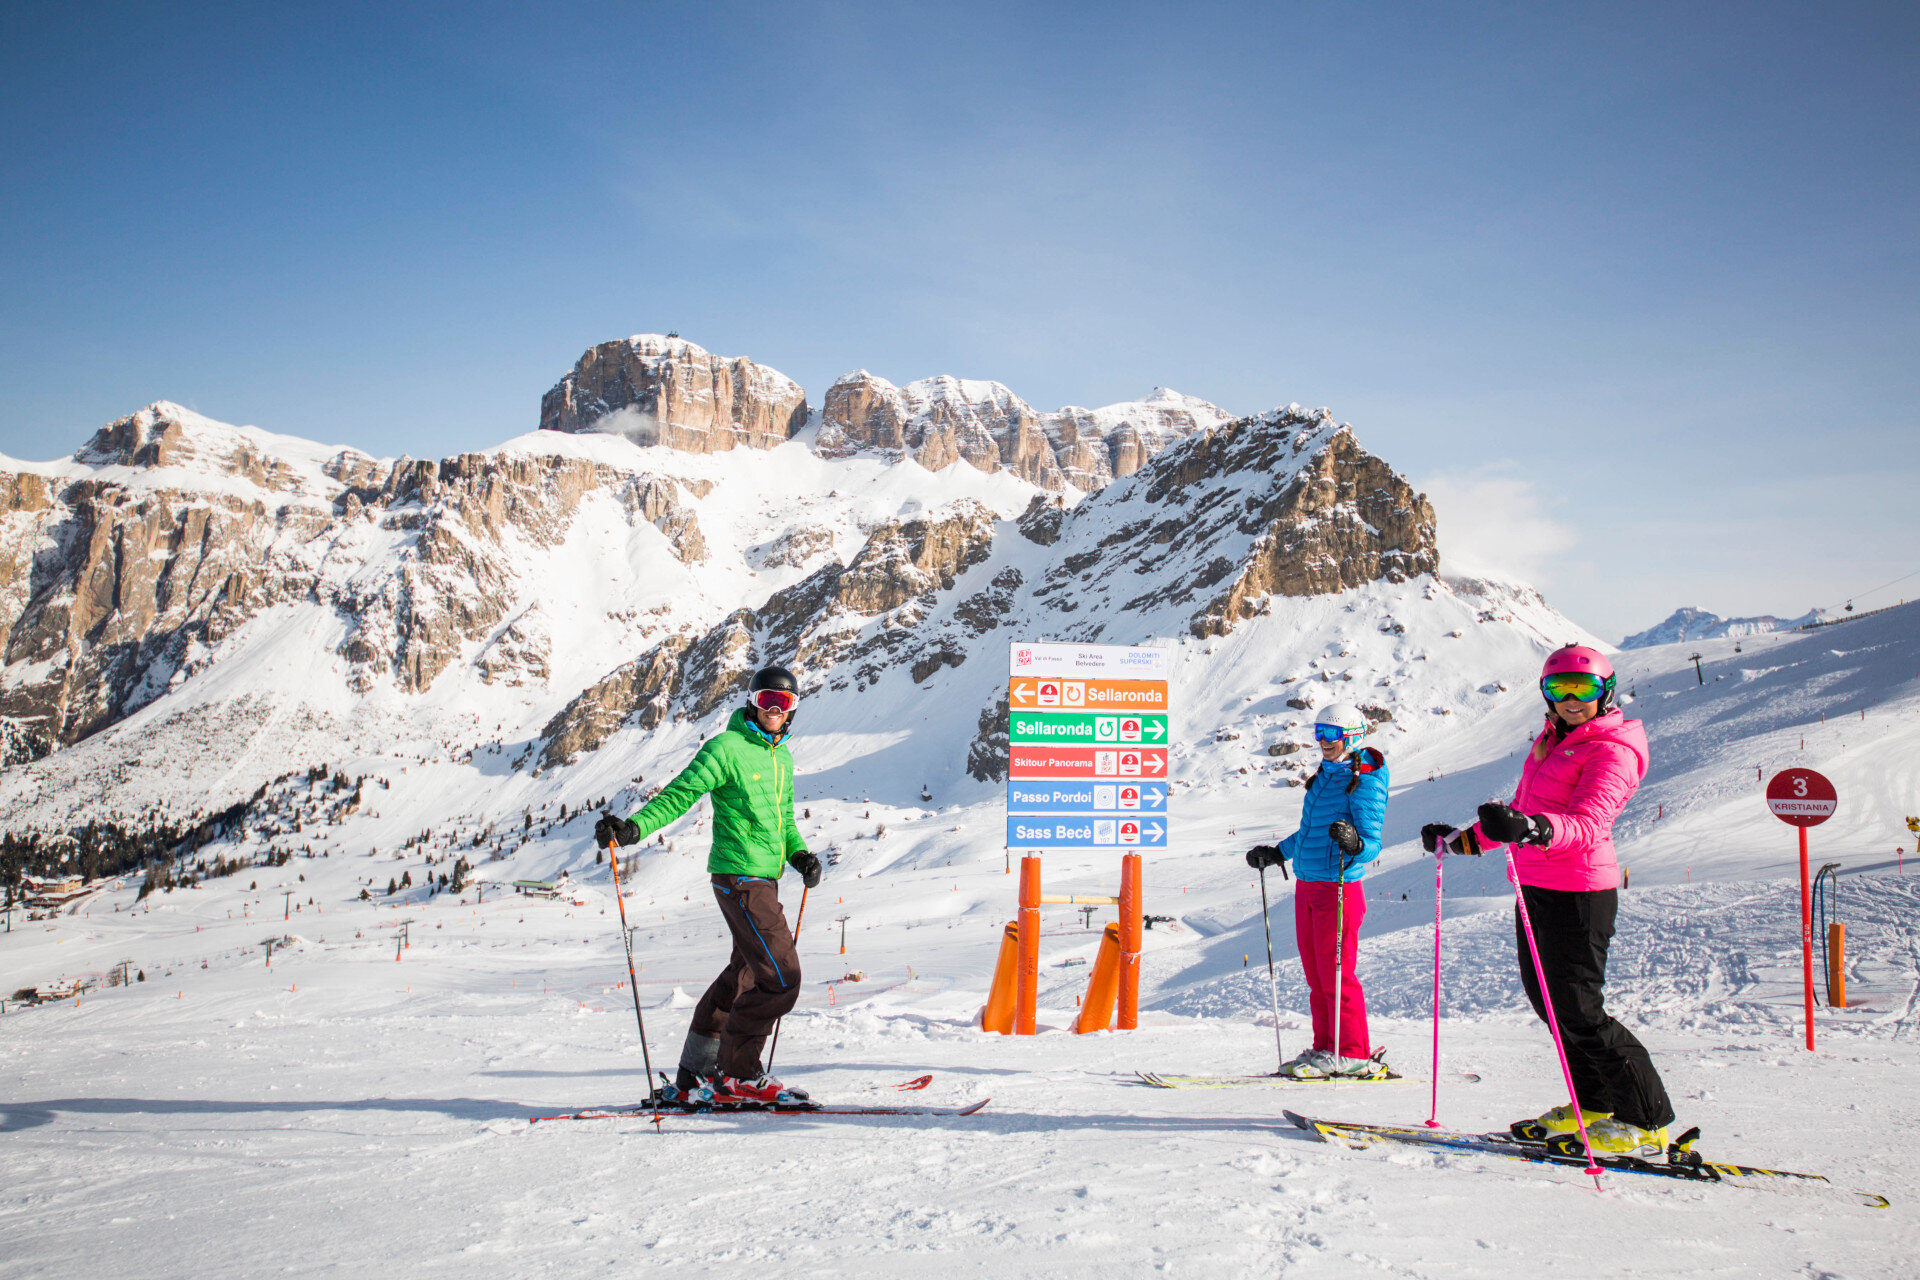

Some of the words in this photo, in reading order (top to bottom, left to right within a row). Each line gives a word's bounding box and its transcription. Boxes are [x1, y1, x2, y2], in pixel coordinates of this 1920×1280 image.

[1046, 685, 1052, 695] 4
[1088, 688, 1162, 702] Sellaronda
[1016, 721, 1092, 735] Sellaronda
[1128, 722, 1134, 731] 3
[1014, 758, 1047, 767] Skitour
[1048, 758, 1093, 768] Panorama
[1127, 755, 1133, 765] 3
[1792, 778, 1808, 797] 3
[1013, 791, 1050, 803] Passo
[1053, 791, 1092, 803] Pordoi
[1126, 789, 1133, 799] 3
[1774, 803, 1829, 811] KRISTIANIA
[1016, 825, 1051, 839] Sass
[1056, 825, 1092, 840] Becè
[1126, 824, 1133, 834] 3
